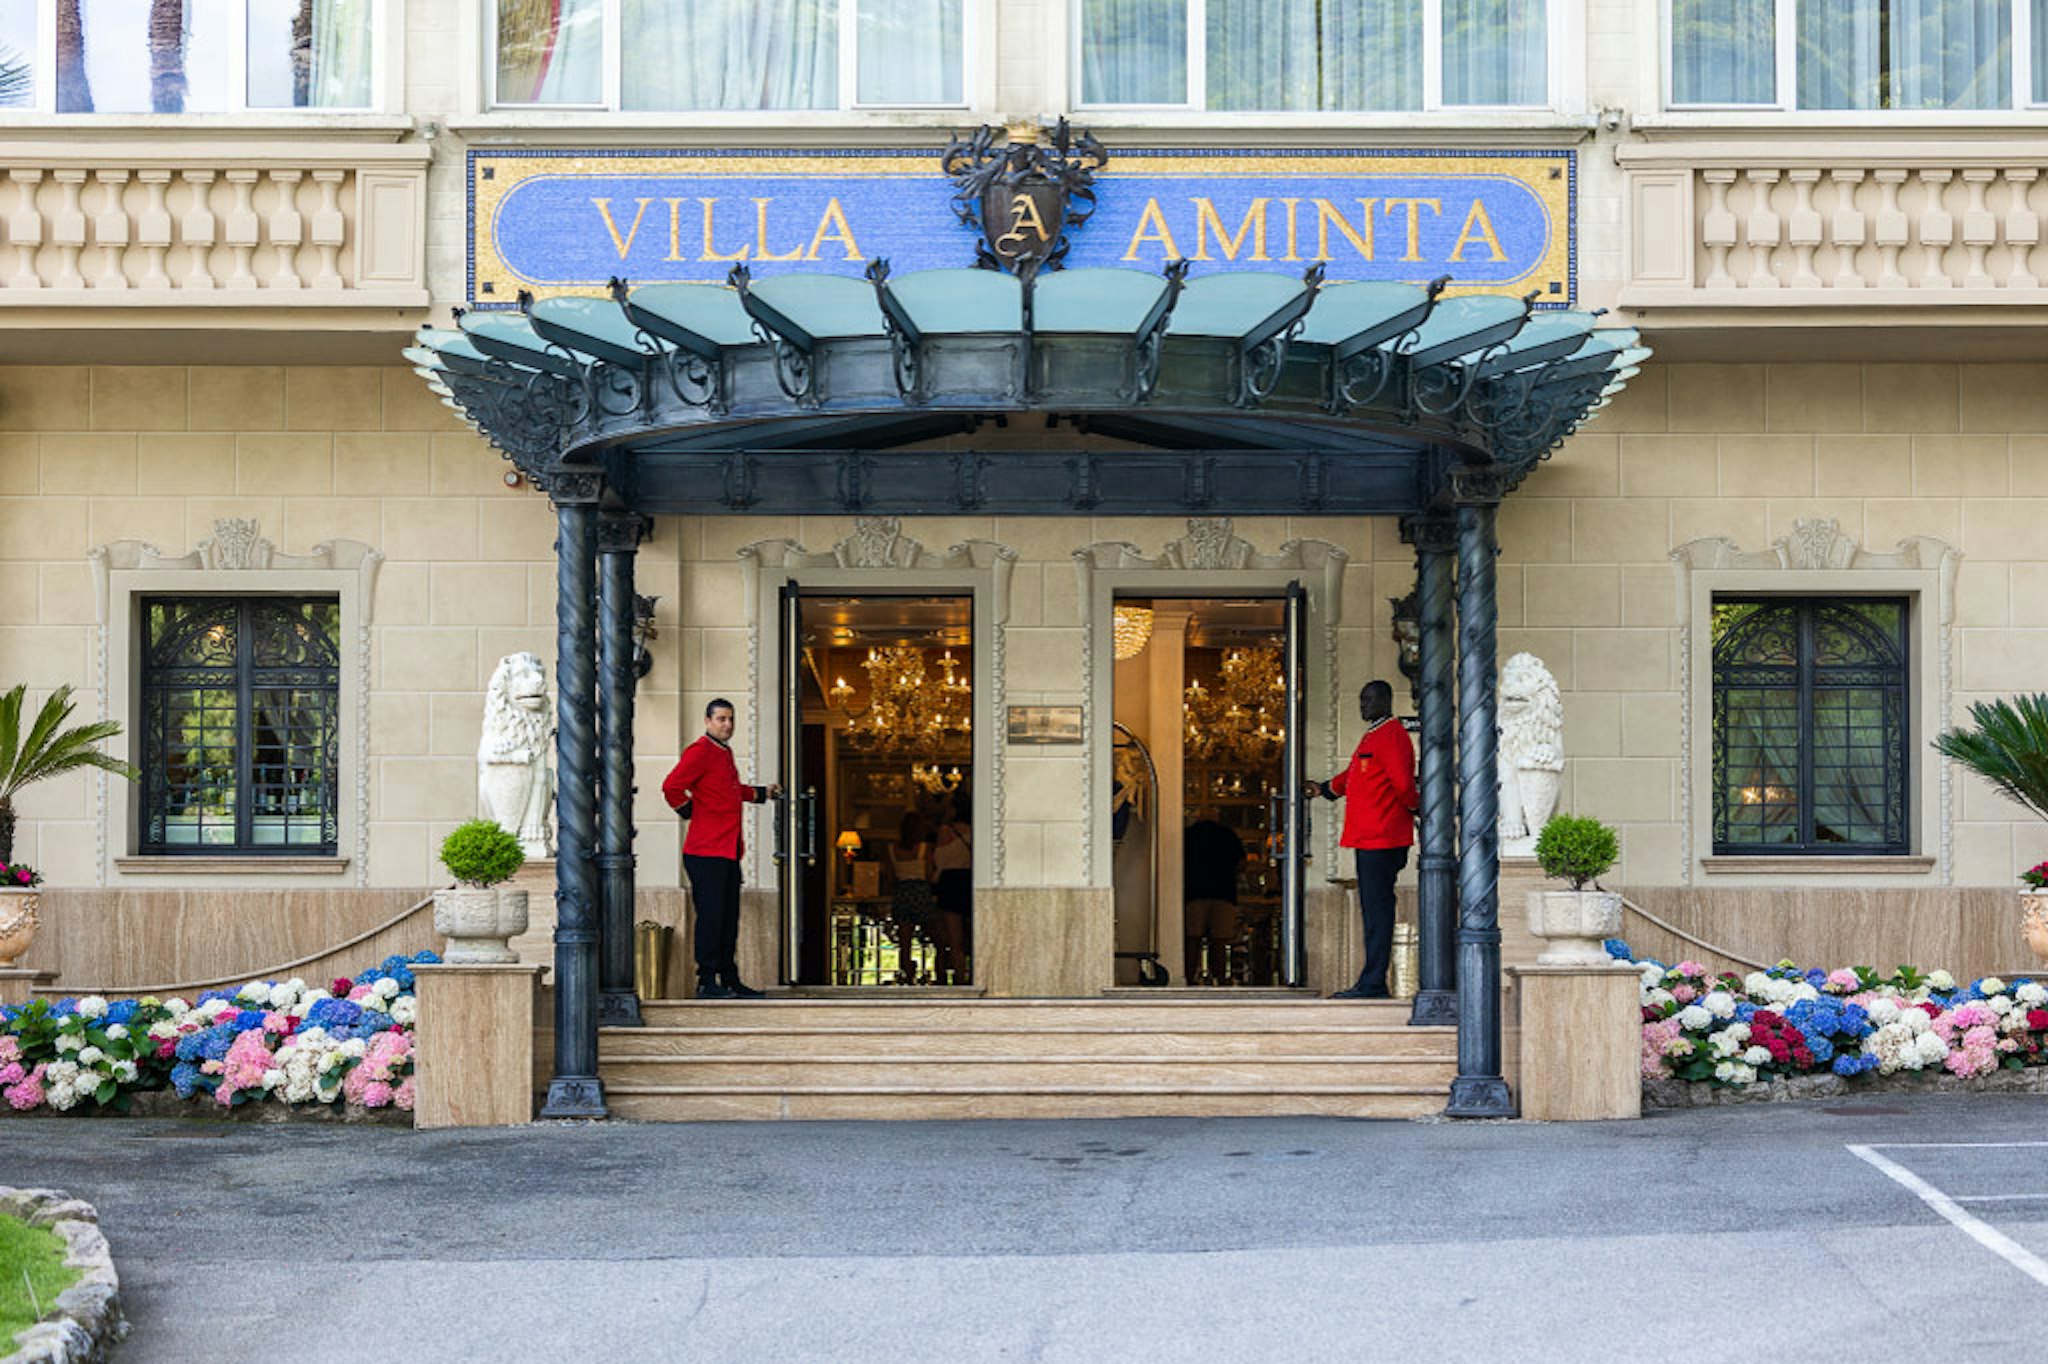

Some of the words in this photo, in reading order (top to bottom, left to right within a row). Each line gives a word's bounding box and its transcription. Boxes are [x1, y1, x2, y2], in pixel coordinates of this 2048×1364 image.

[591, 197, 866, 262] VILLA
[1120, 197, 1509, 262] AMINTA
[995, 193, 1050, 257] A
